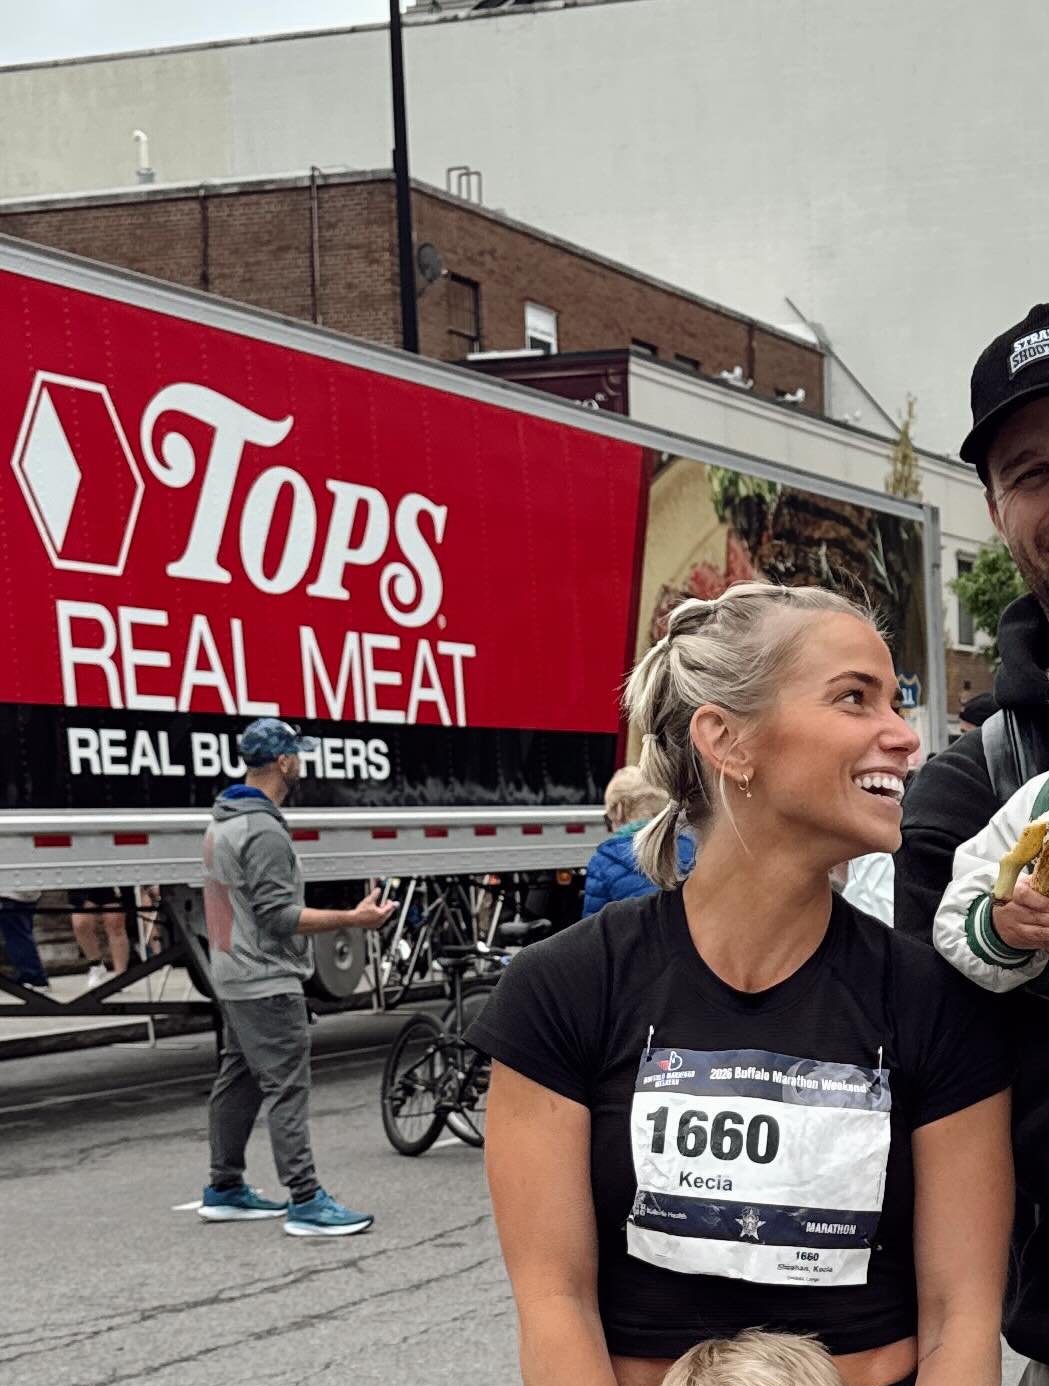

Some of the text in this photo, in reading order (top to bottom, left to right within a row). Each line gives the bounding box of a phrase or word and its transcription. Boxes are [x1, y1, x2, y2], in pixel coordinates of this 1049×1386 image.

[56, 599, 477, 728] REAL MEAT
[66, 727, 391, 781] REAL BUHERS
[709, 1068, 733, 1081] 2026
[735, 1066, 770, 1081] Buffalo
[772, 1070, 819, 1090] Marathon
[821, 1078, 867, 1093] Weekend
[646, 1105, 781, 1165] 1660
[679, 1171, 733, 1192] Kecia
[806, 1221, 857, 1235] MARATHON
[795, 1251, 820, 1262] 1660
